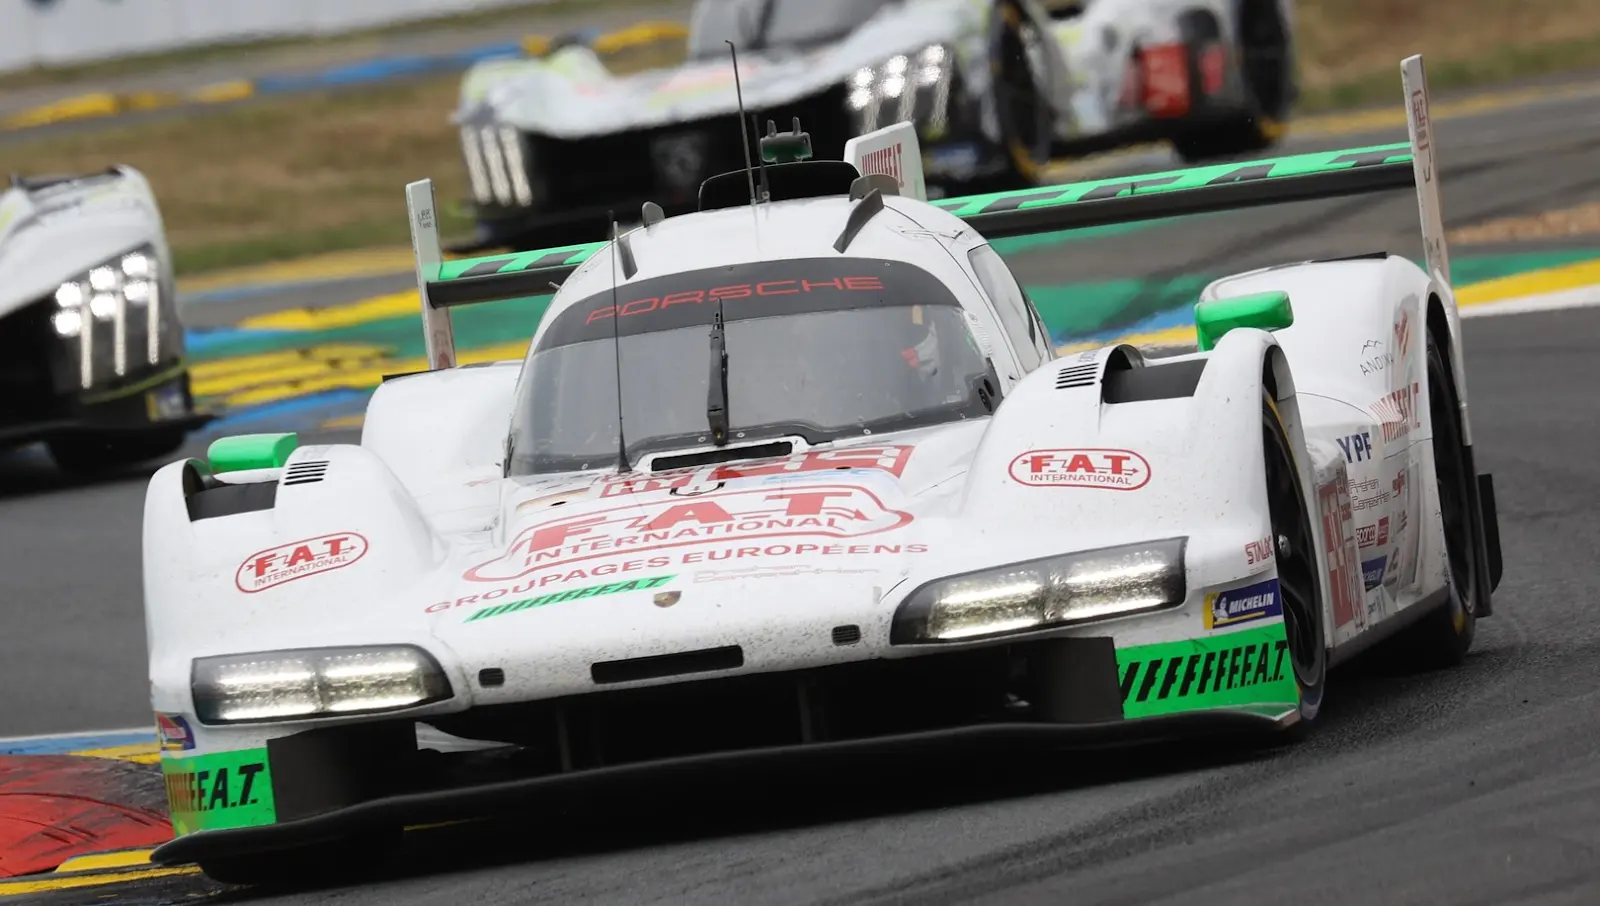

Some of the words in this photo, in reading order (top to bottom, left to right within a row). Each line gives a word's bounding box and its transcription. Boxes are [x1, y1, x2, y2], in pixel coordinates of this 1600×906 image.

[585, 277, 885, 325] PORSCHE
[1336, 432, 1372, 463] YPF
[1030, 474, 1132, 485] INTERNATIONAL
[525, 516, 848, 567] INTERNATIONAL
[253, 555, 350, 588] INTERNATIONAL
[424, 555, 671, 614] GROUPAGES
[681, 542, 929, 567] EUROPÉENS
[1228, 592, 1274, 615] MICHELIN
